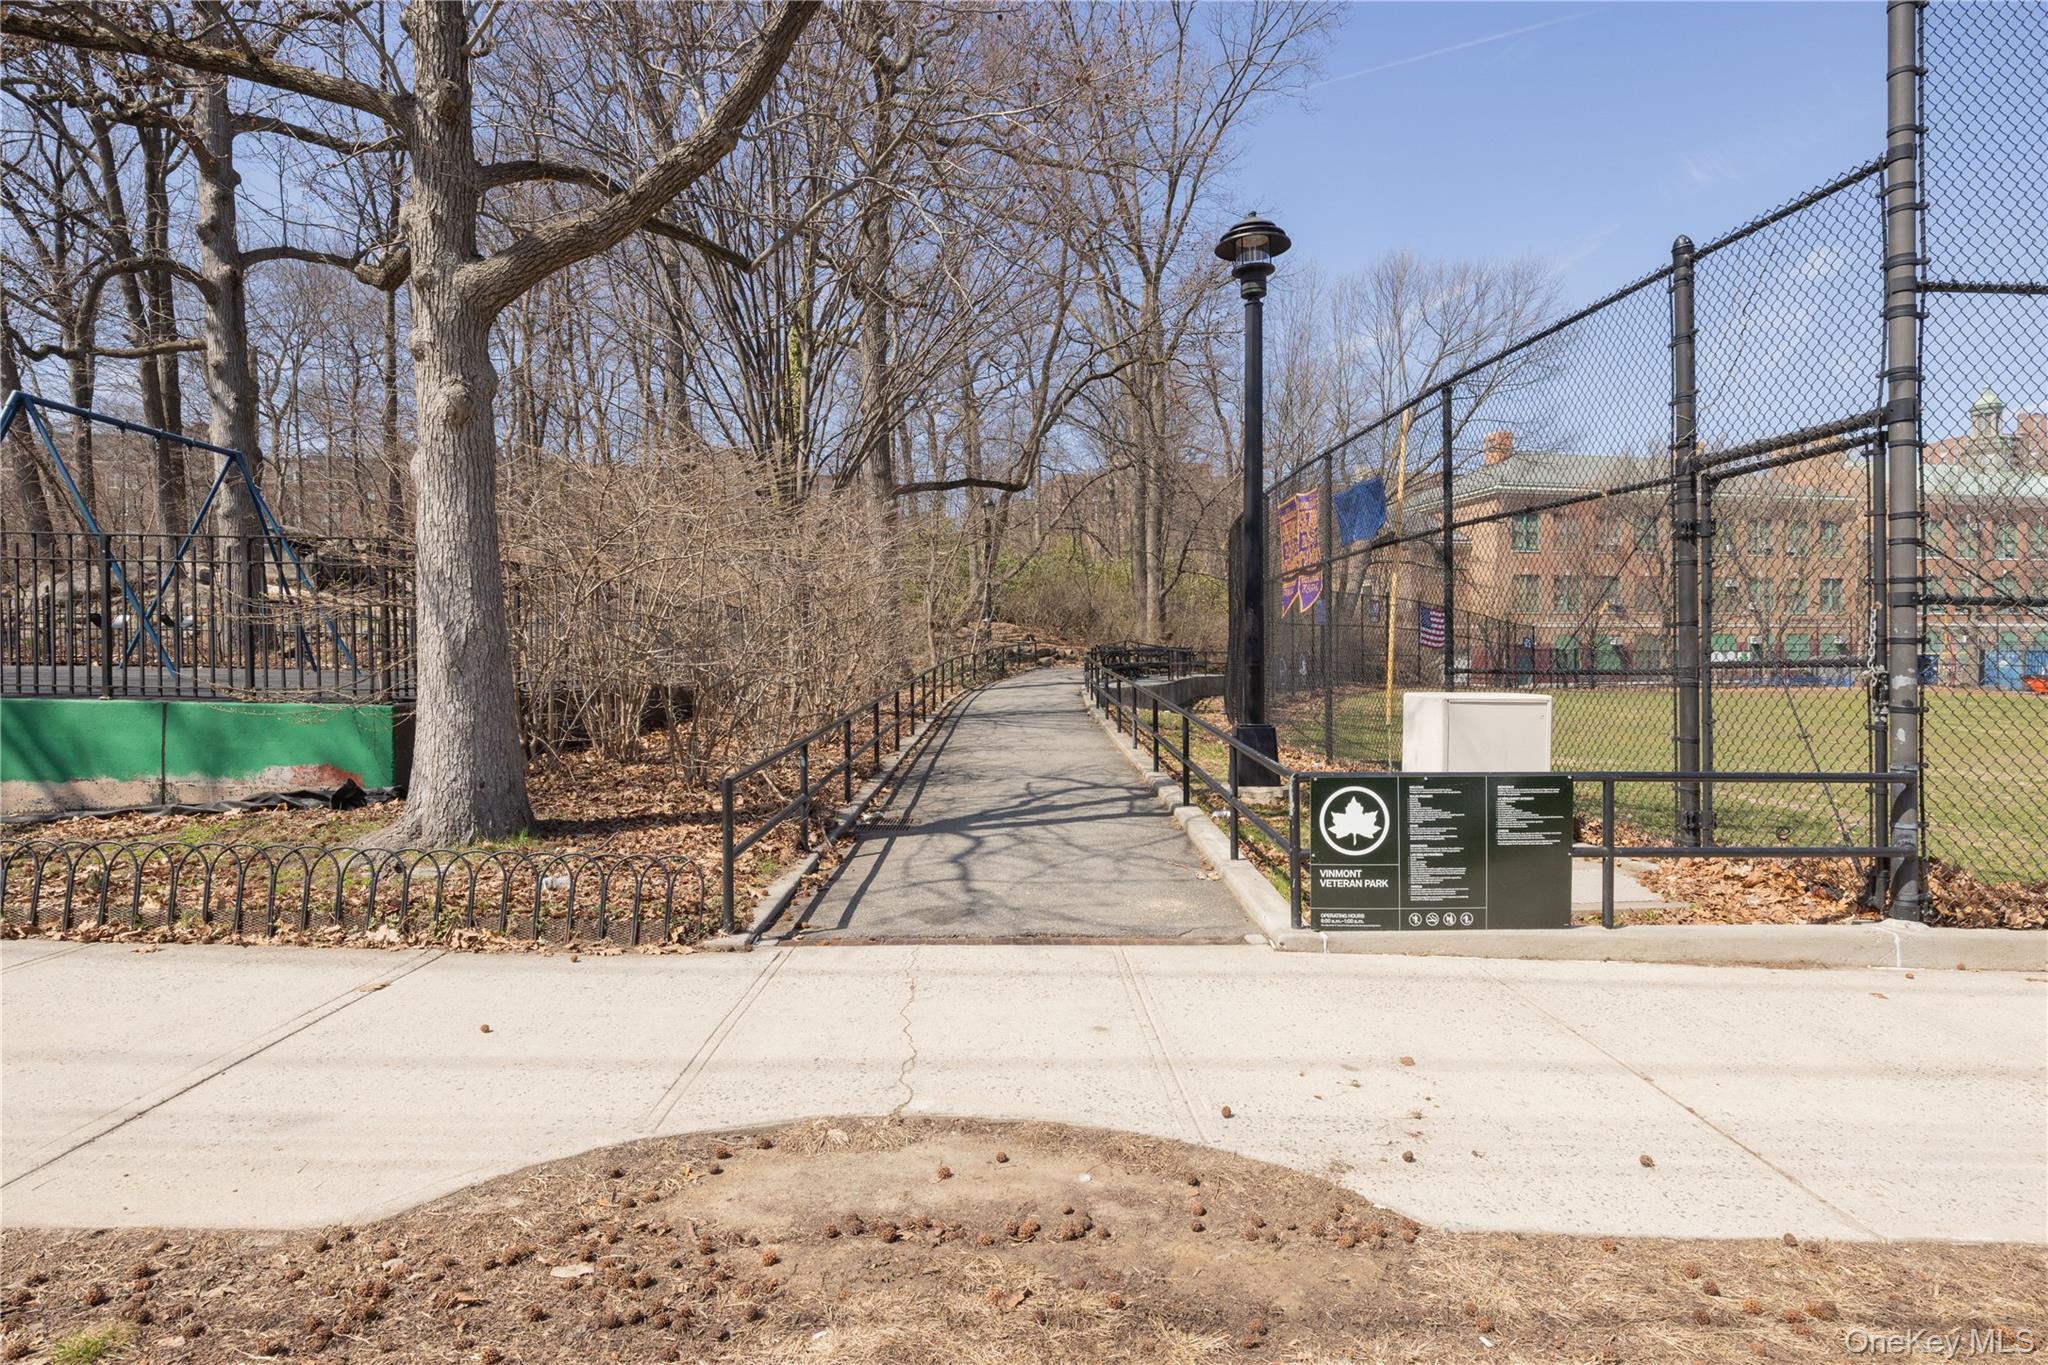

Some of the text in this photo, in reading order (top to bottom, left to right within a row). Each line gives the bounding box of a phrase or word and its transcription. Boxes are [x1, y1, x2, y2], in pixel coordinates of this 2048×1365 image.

[1319, 869, 1363, 878] VINMONT
[1319, 879, 1389, 888] VETERAN PARK
